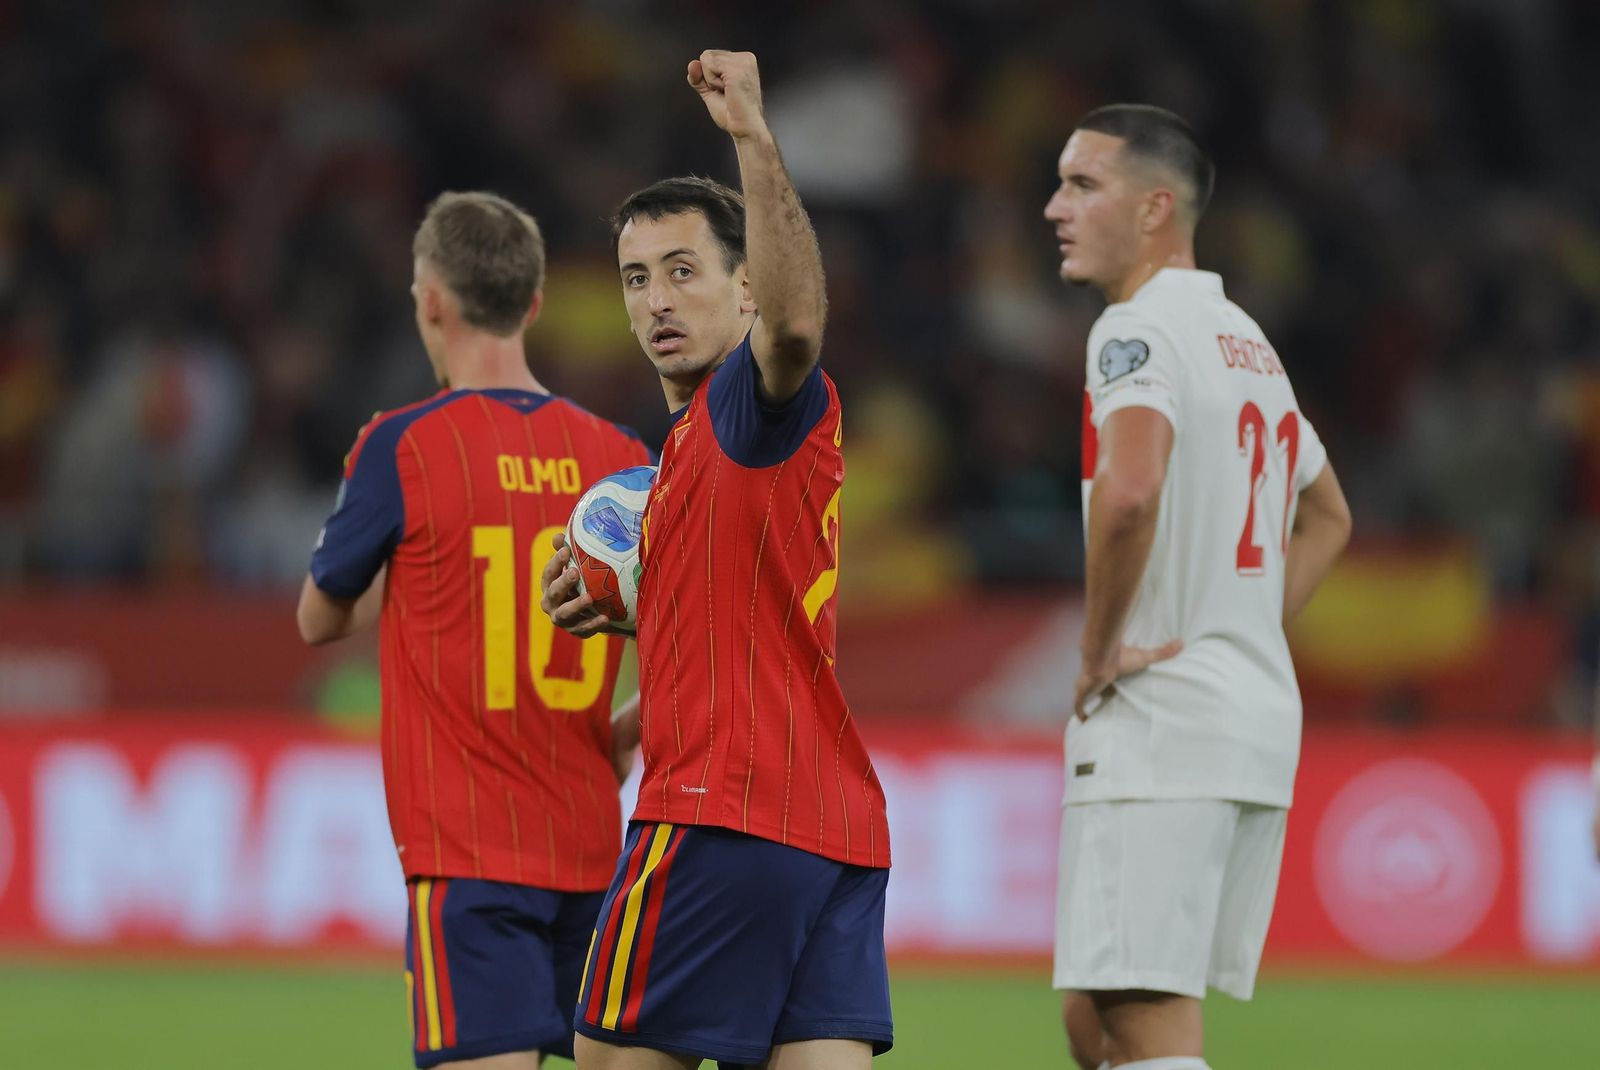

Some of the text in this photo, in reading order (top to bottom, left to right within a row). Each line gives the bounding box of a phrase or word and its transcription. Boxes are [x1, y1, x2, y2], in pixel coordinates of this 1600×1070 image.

[497, 454, 582, 494] OLMO
[1236, 400, 1299, 577] 21
[472, 526, 609, 711] 10
